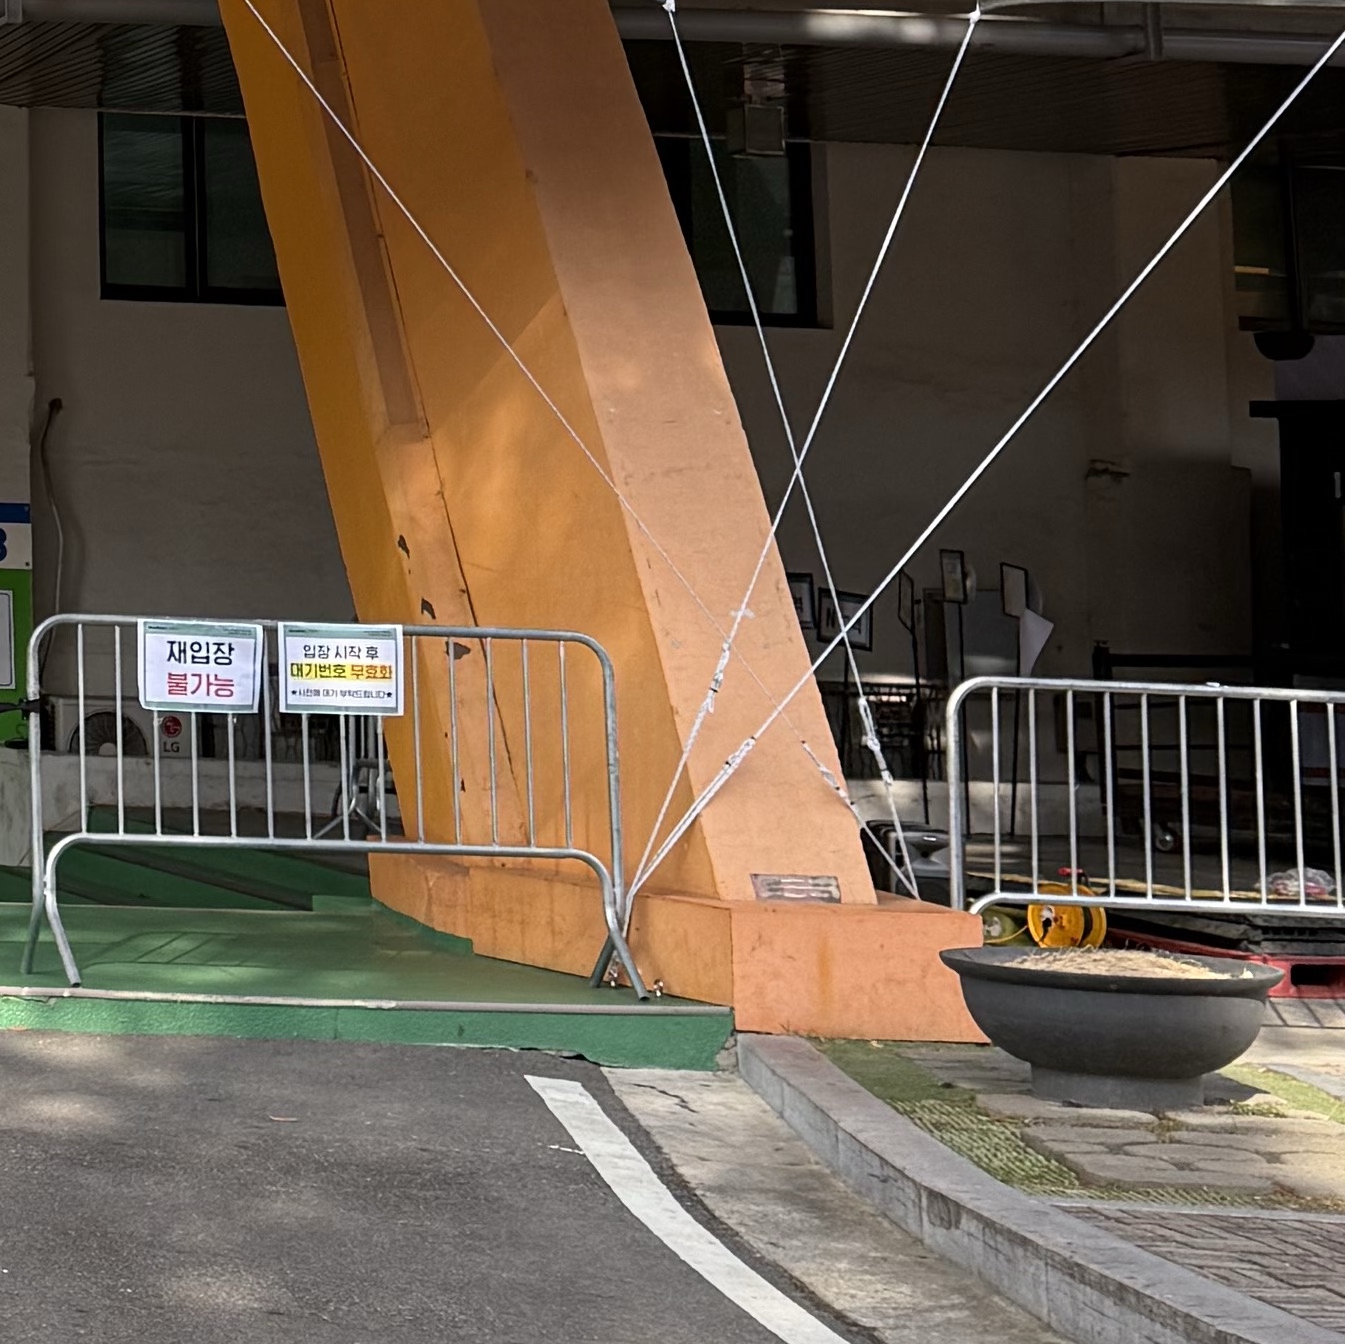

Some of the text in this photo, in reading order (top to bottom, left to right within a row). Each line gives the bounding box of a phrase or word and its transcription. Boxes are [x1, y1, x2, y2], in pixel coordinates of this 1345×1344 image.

[166, 640, 235, 665] 재입장
[303, 644, 379, 660] 입장 시작 후
[290, 663, 347, 678] 대기번호
[167, 672, 235, 697] 불가능
[163, 741, 180, 752] LG
